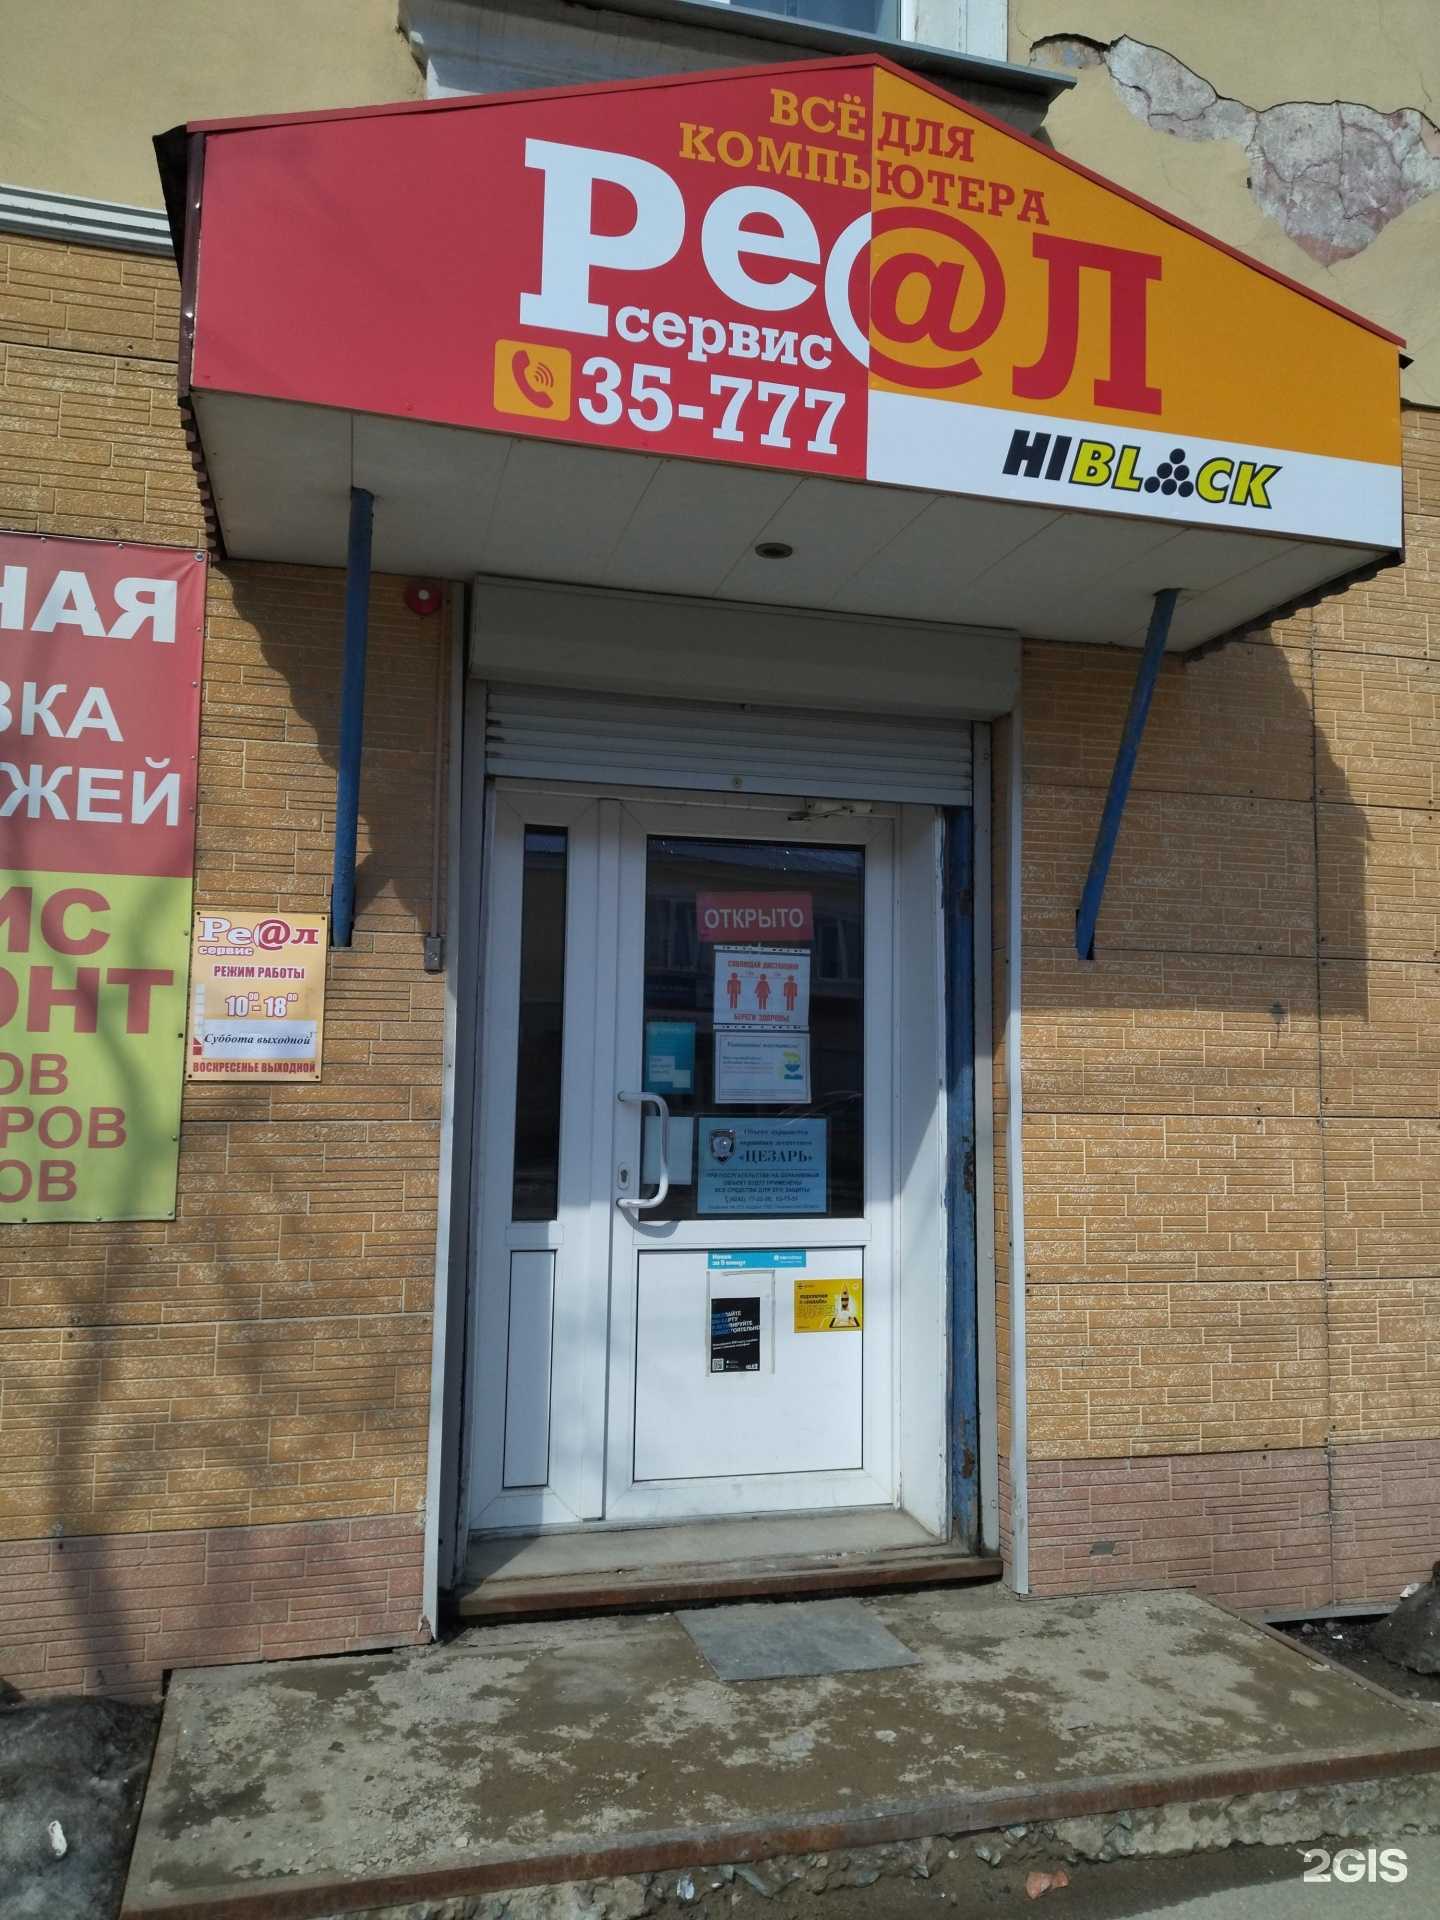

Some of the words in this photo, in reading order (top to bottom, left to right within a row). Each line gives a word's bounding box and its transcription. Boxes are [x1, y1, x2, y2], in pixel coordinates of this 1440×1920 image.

[769, 87, 867, 143] ВСЁ
[876, 109, 975, 164] ДЛЯ
[678, 121, 1051, 227] КОМПЬЮТЕРА
[615, 304, 833, 370] сервис
[577, 355, 846, 456] 35-777
[0, 680, 124, 742] КА
[0, 756, 181, 826] ЖЕЙ
[704, 908, 804, 928] ОТКРЫТО
[0, 964, 174, 1034] НТ
[213, 965, 255, 979] РЕЖИМ
[257, 967, 305, 979] РАБОТЫ
[204, 1033, 254, 1045] Суббота
[256, 1032, 313, 1045] выходной
[739, 1150, 813, 1164] «ЦЕЗАРЬ»
